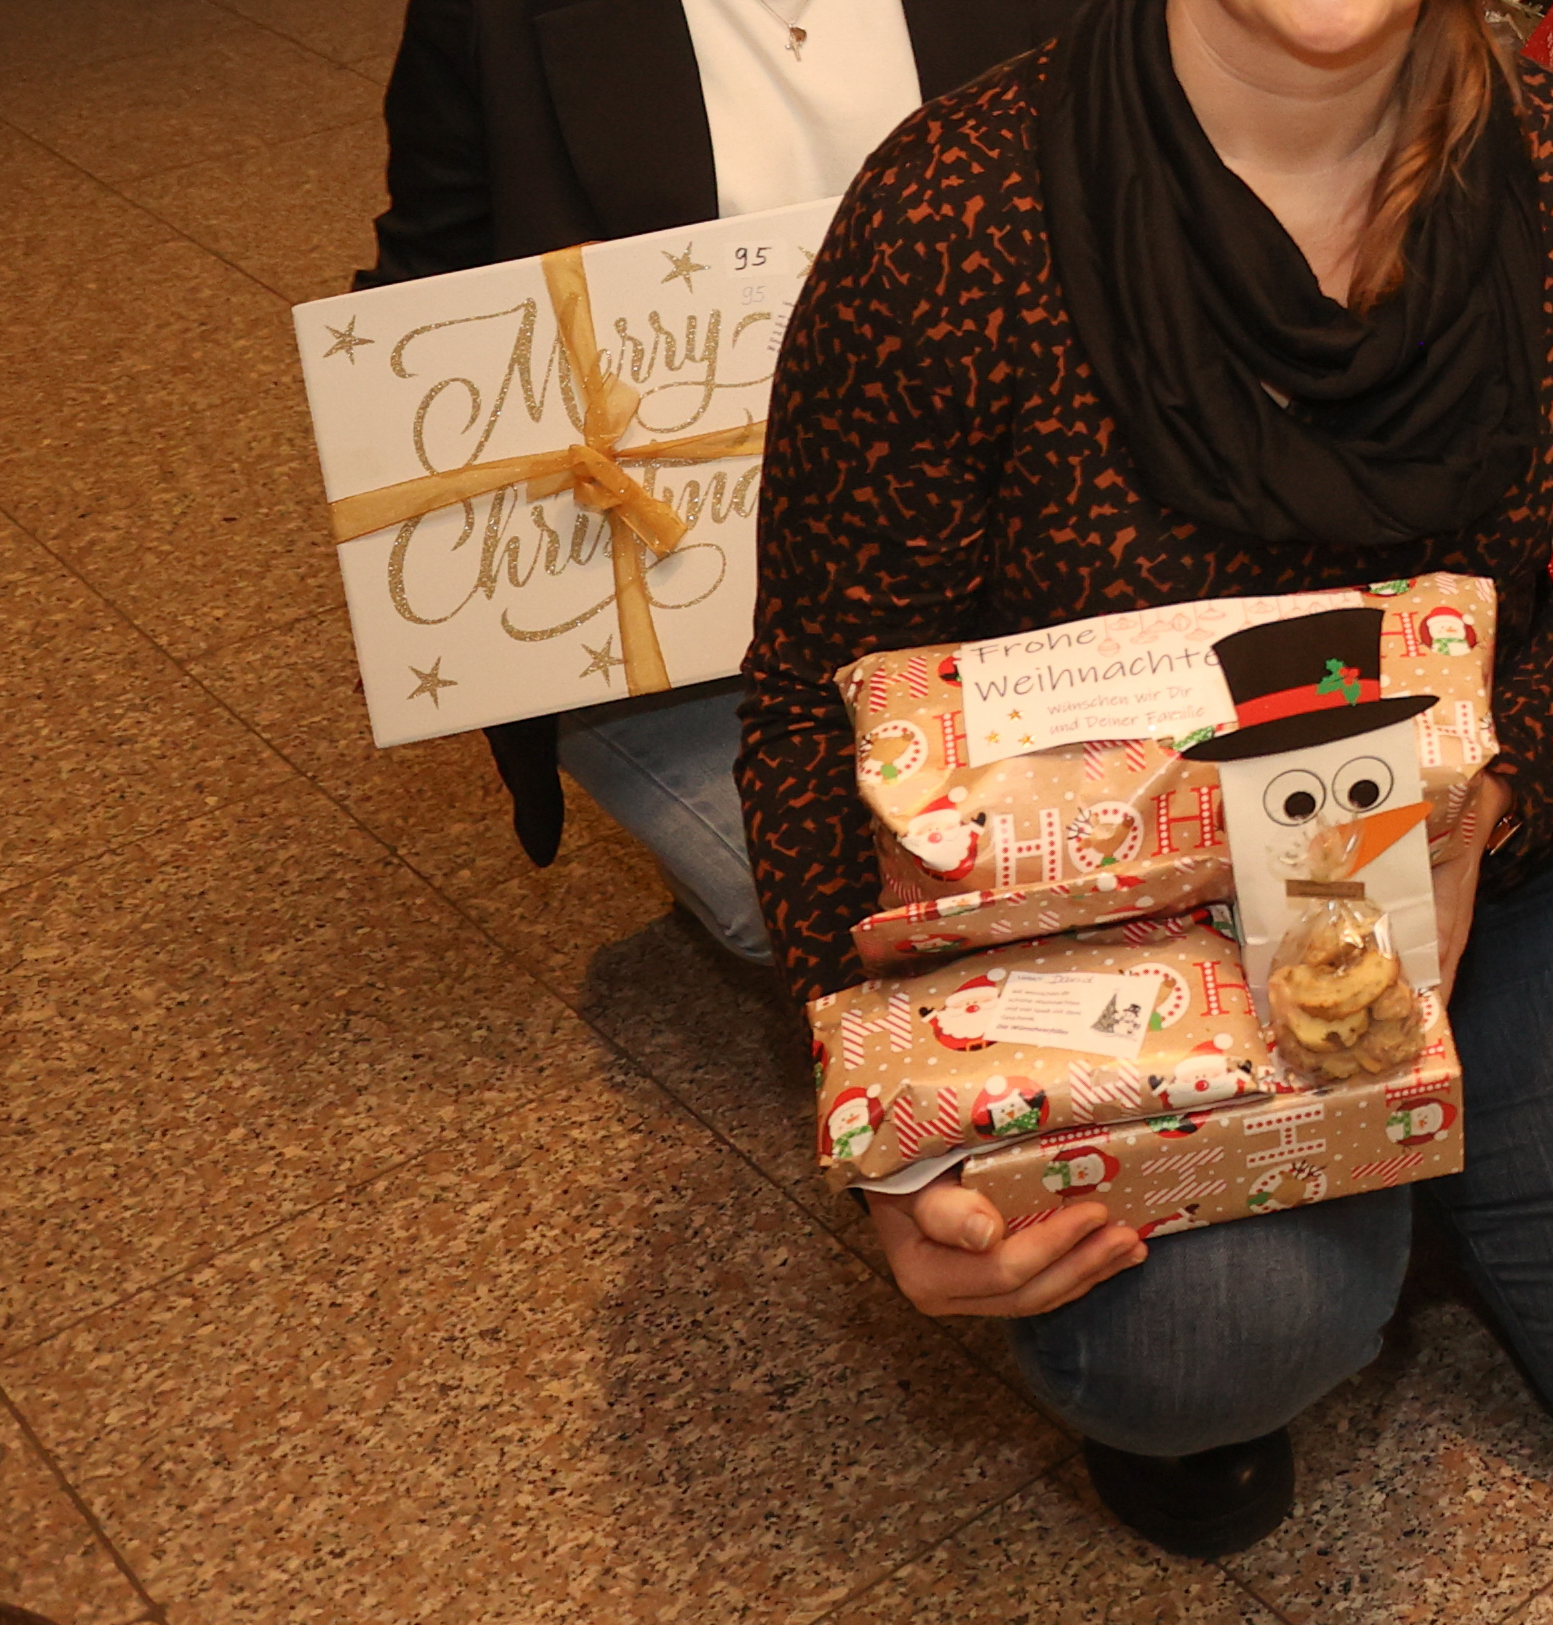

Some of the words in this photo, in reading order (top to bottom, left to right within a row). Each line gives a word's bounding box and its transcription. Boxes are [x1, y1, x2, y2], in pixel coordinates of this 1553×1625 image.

[734, 246, 772, 271] 95
[742, 285, 765, 306] 95
[390, 295, 773, 476] Merry
[970, 628, 1096, 664] Frohe
[974, 647, 1221, 702] Weihnachte
[1046, 693, 1129, 716] wünschen
[1133, 688, 1161, 704] wir
[1166, 685, 1193, 700] Dir
[1049, 718, 1080, 735] und
[1083, 712, 1139, 730] Deiner
[1146, 704, 1206, 726] Familie
